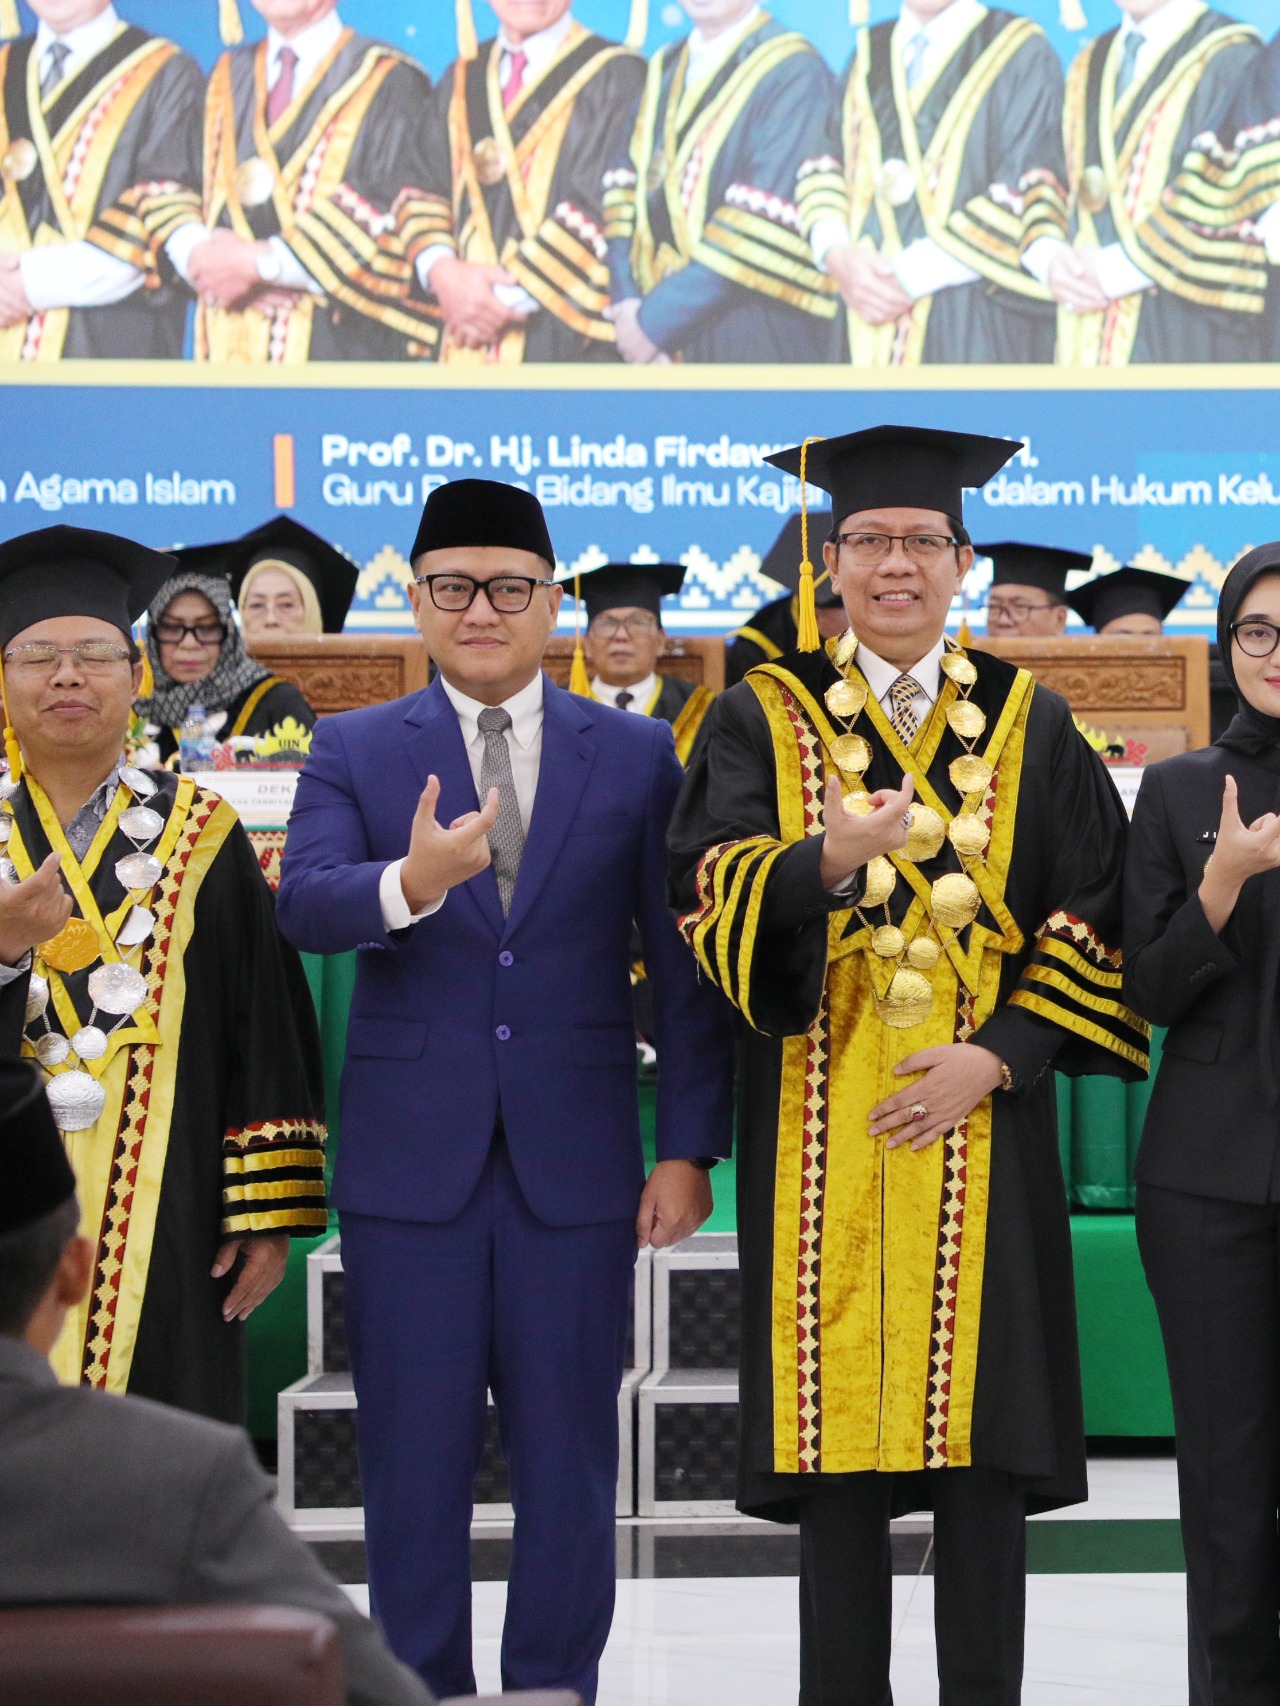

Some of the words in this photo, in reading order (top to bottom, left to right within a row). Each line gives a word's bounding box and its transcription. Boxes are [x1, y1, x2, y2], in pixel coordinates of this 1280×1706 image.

[321, 432, 420, 468] Prof.
[426, 434, 484, 468] Dr.
[489, 434, 542, 476] Hj.
[547, 433, 648, 468] Linda
[654, 433, 803, 469] Firdaw
[13, 470, 139, 512] Agama
[145, 470, 237, 505] Islam
[322, 473, 414, 507] Guru
[536, 474, 655, 514] Bidang
[661, 473, 731, 507] Ilmu
[983, 473, 1086, 507] dalam
[1091, 473, 1213, 506] Hukum
[278, 739, 300, 749] UIN
